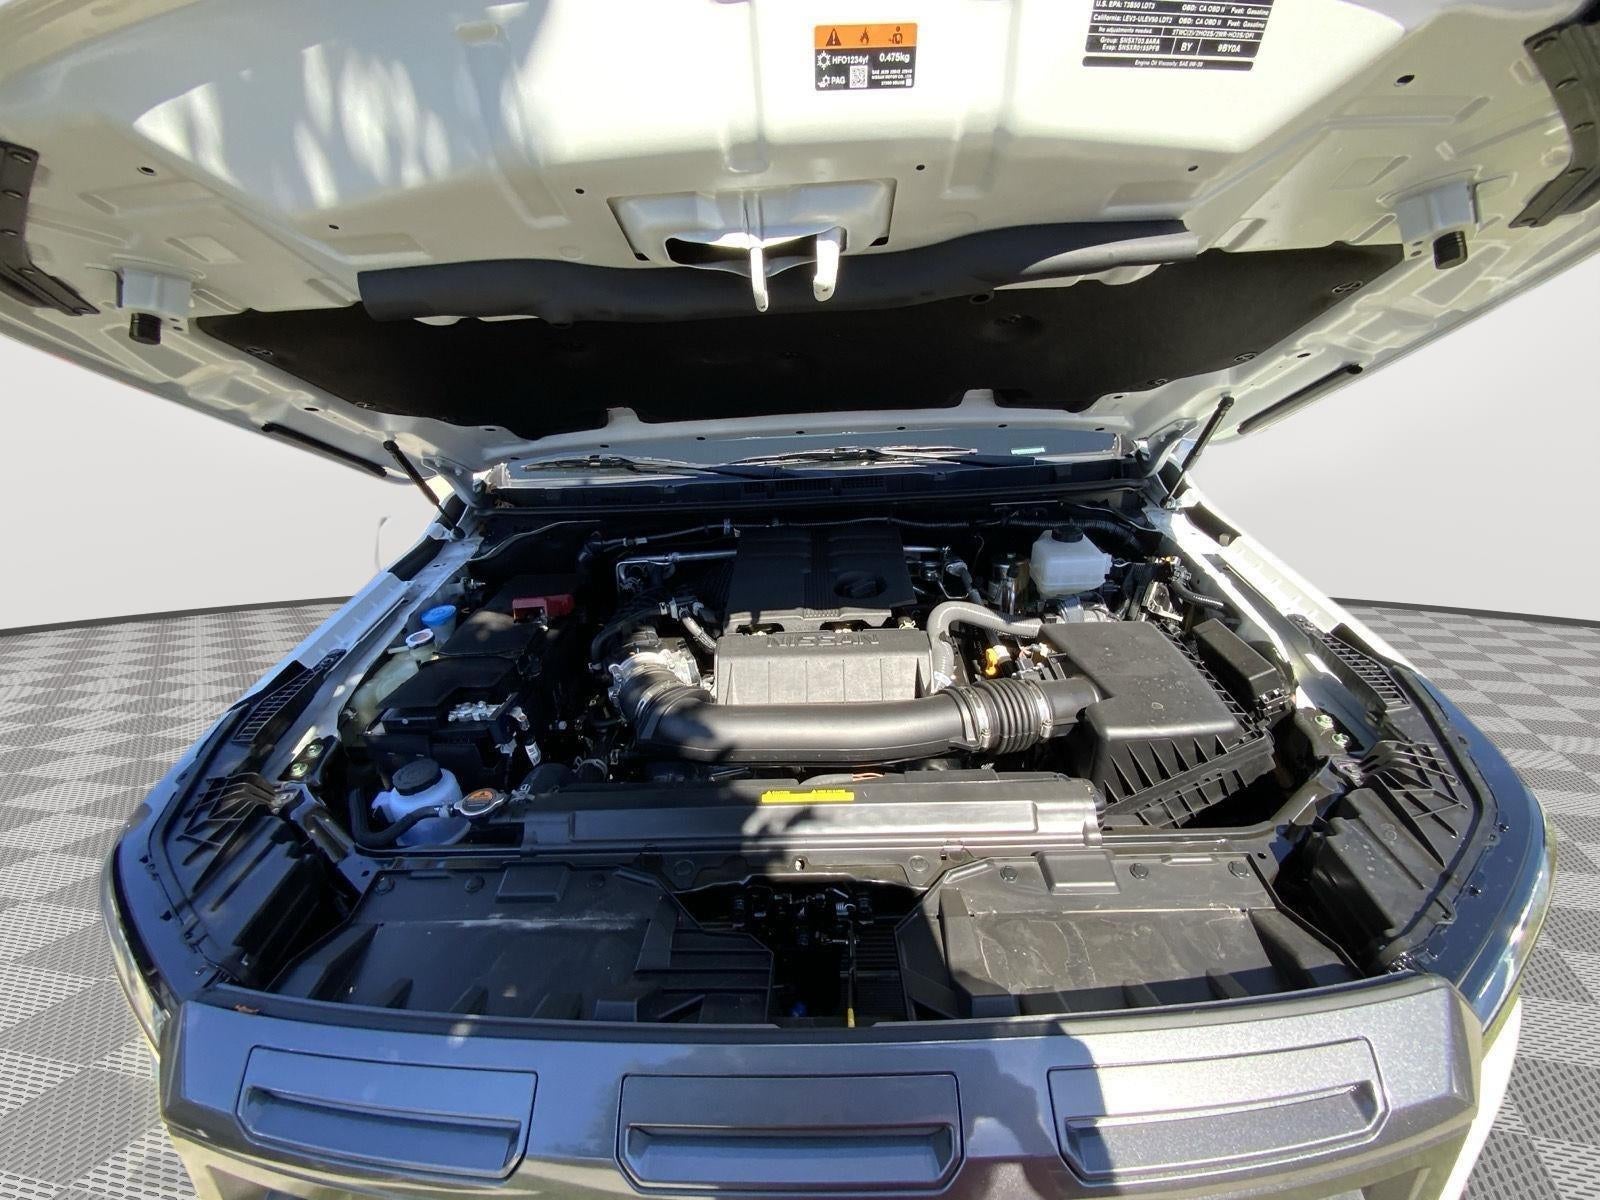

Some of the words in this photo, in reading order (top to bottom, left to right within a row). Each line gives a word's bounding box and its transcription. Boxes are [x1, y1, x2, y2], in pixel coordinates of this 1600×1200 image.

[1181, 4, 1197, 12] OBD:
[1207, 5, 1220, 13] OBD
[1230, 6, 1244, 14] Fuel:
[1246, 8, 1269, 16] Gasoline
[1093, 14, 1122, 22] California:
[1178, 17, 1194, 25] OBD:
[1204, 18, 1217, 26] OBD
[1242, 21, 1266, 29] Gasoline
[1180, 42, 1193, 52] BY
[879, 52, 910, 64] 0.475kg
[831, 76, 846, 85] PAG
[767, 632, 880, 648] NISSAN
